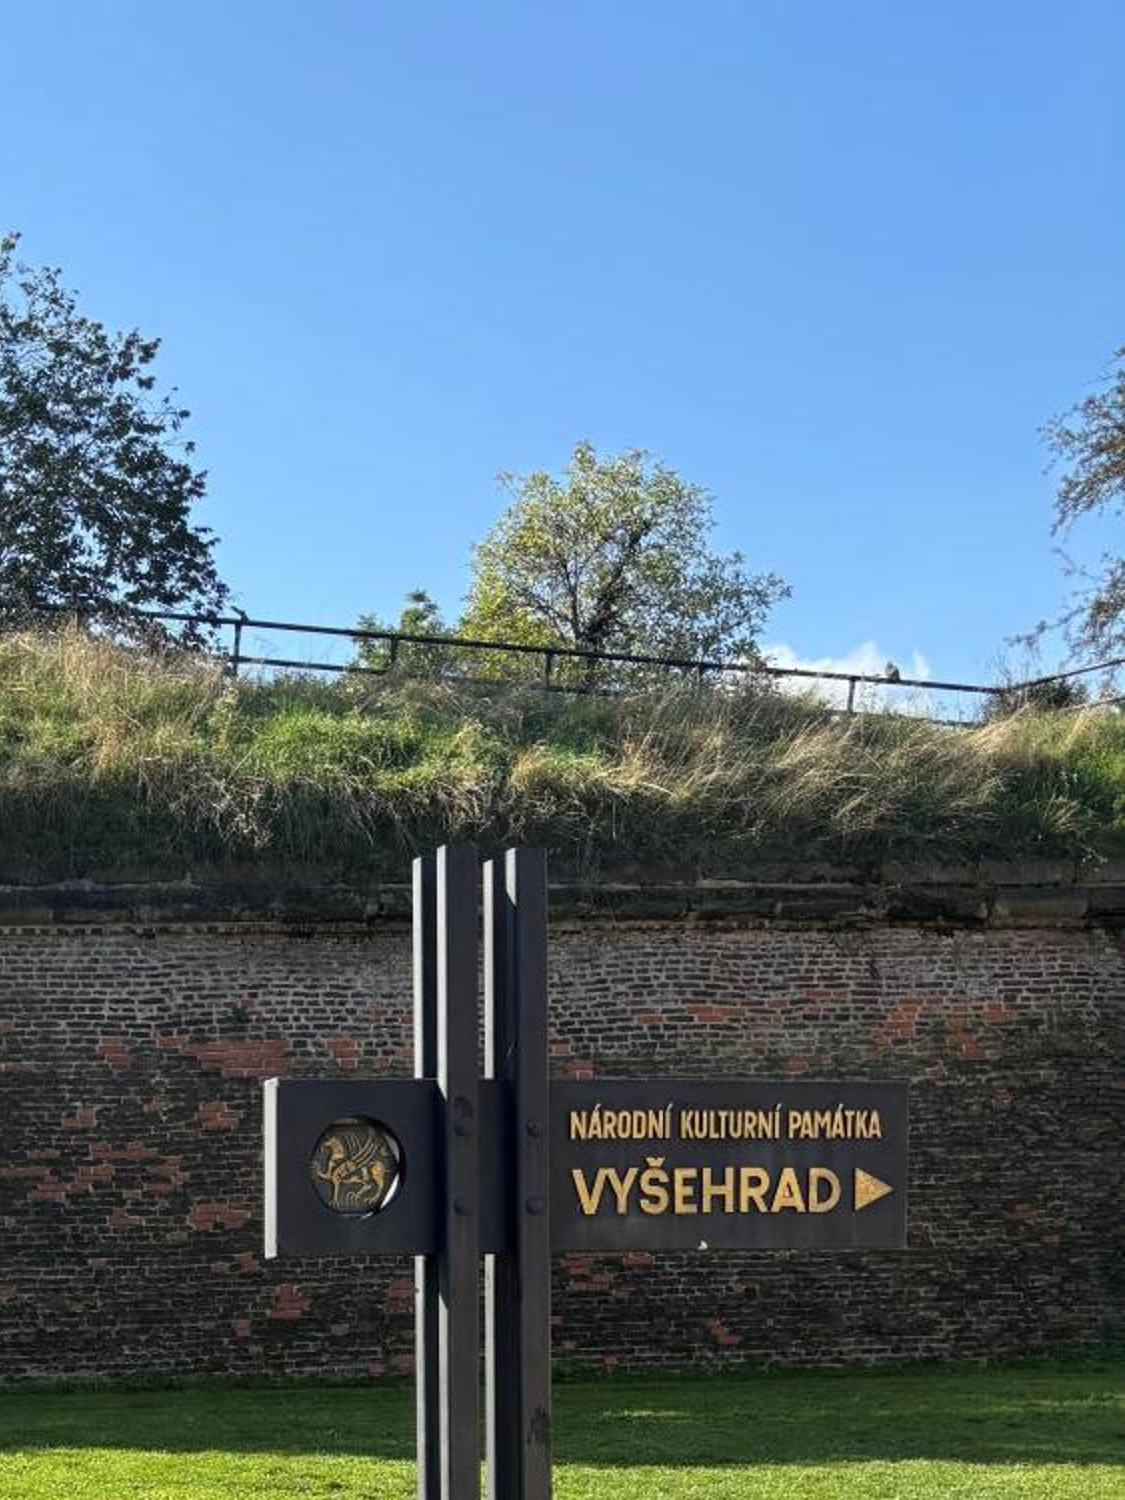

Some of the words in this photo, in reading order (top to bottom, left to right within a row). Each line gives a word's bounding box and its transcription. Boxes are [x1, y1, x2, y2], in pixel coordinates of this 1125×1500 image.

[570, 1103, 673, 1140] NÁRODNÍ
[680, 1103, 782, 1139] KULTURNÍ
[788, 1103, 882, 1139] PAMÁTKA
[571, 1156, 842, 1215] VYŠEHRAD
